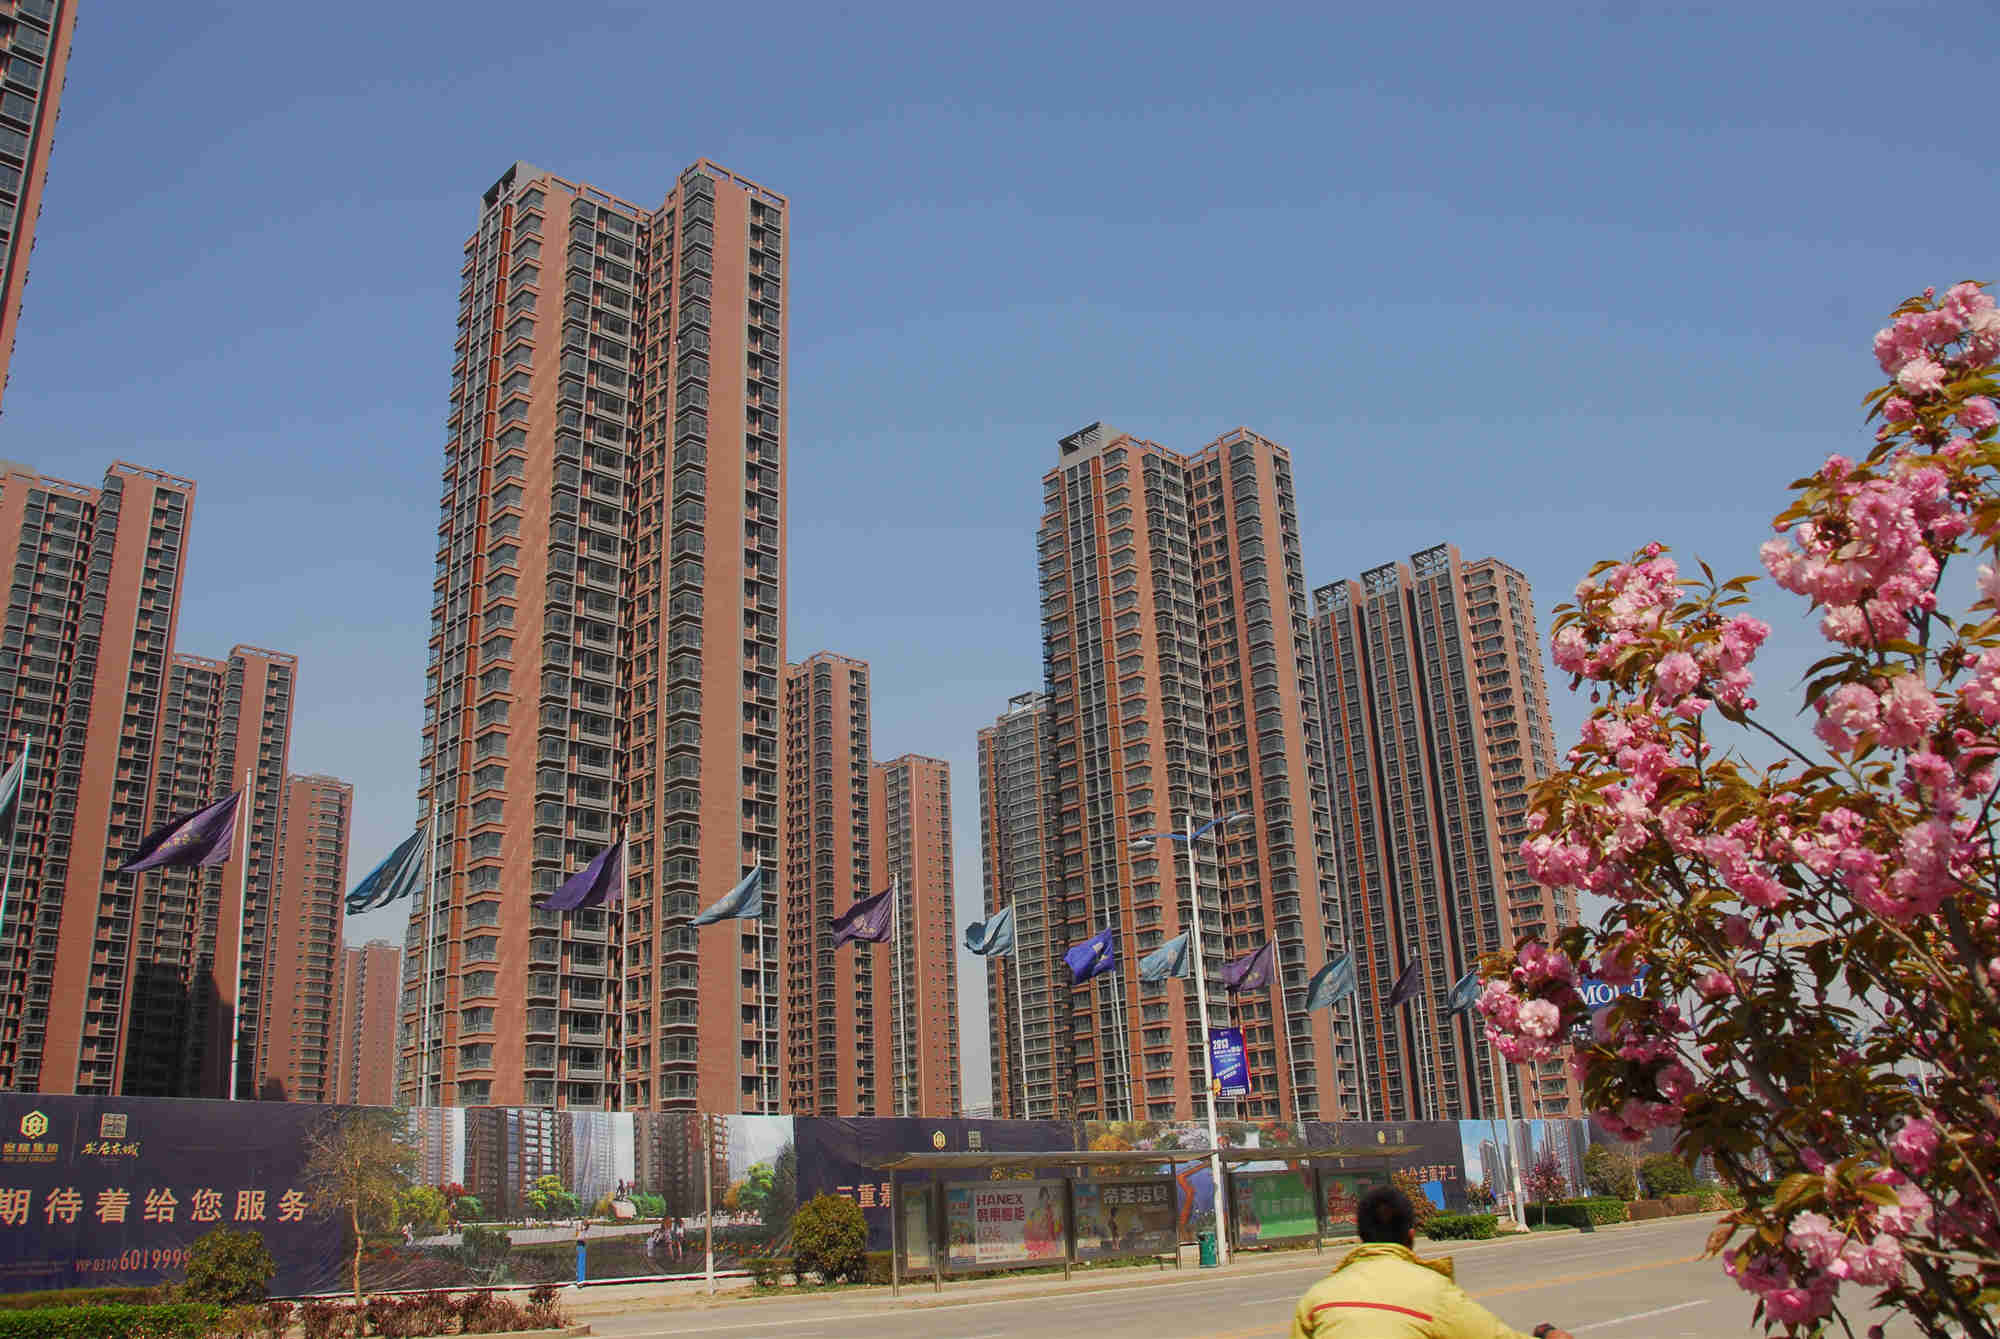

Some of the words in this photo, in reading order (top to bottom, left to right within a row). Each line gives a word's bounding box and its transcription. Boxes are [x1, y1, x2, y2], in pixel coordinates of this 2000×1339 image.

[0, 1187, 310, 1224] 期待着给您服务
[976, 1192, 1024, 1206] HANEX
